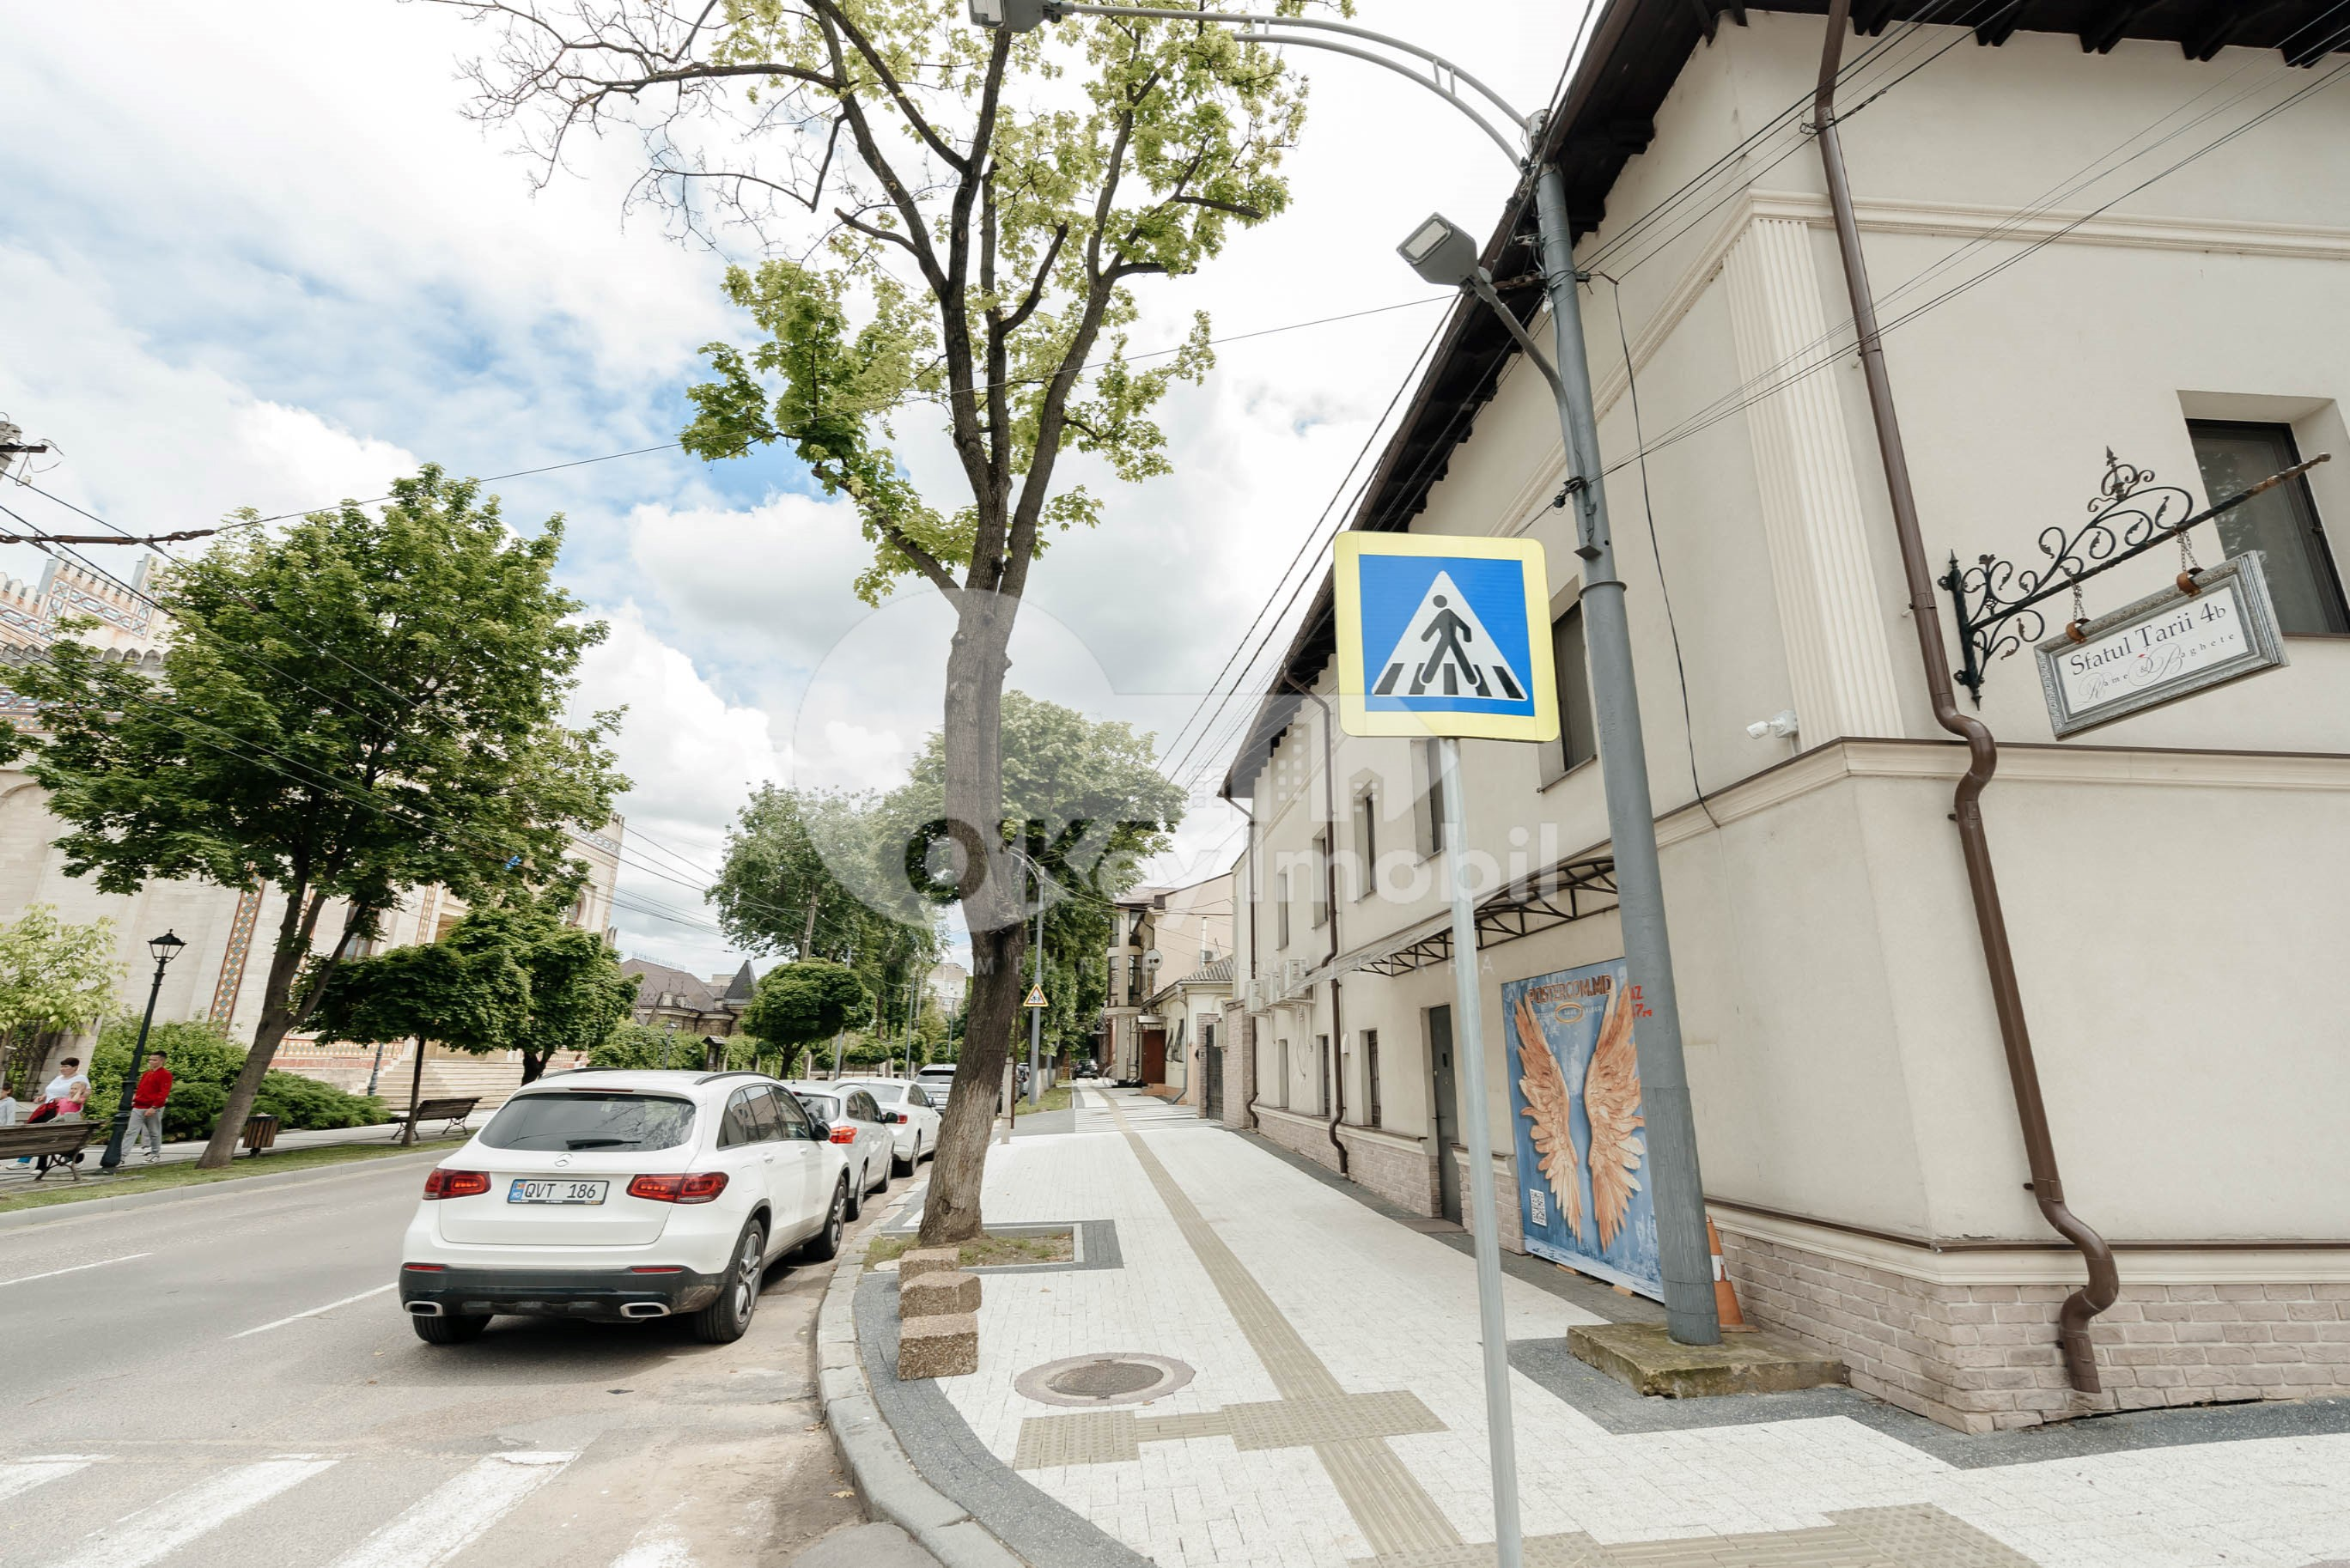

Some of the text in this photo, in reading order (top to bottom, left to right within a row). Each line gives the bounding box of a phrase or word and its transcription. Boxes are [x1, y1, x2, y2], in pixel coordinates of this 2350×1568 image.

[2070, 636, 2132, 675] Sfatul
[2200, 603, 2226, 623] 4b
[525, 1183, 557, 1198] QVT
[566, 1184, 596, 1199] 186
